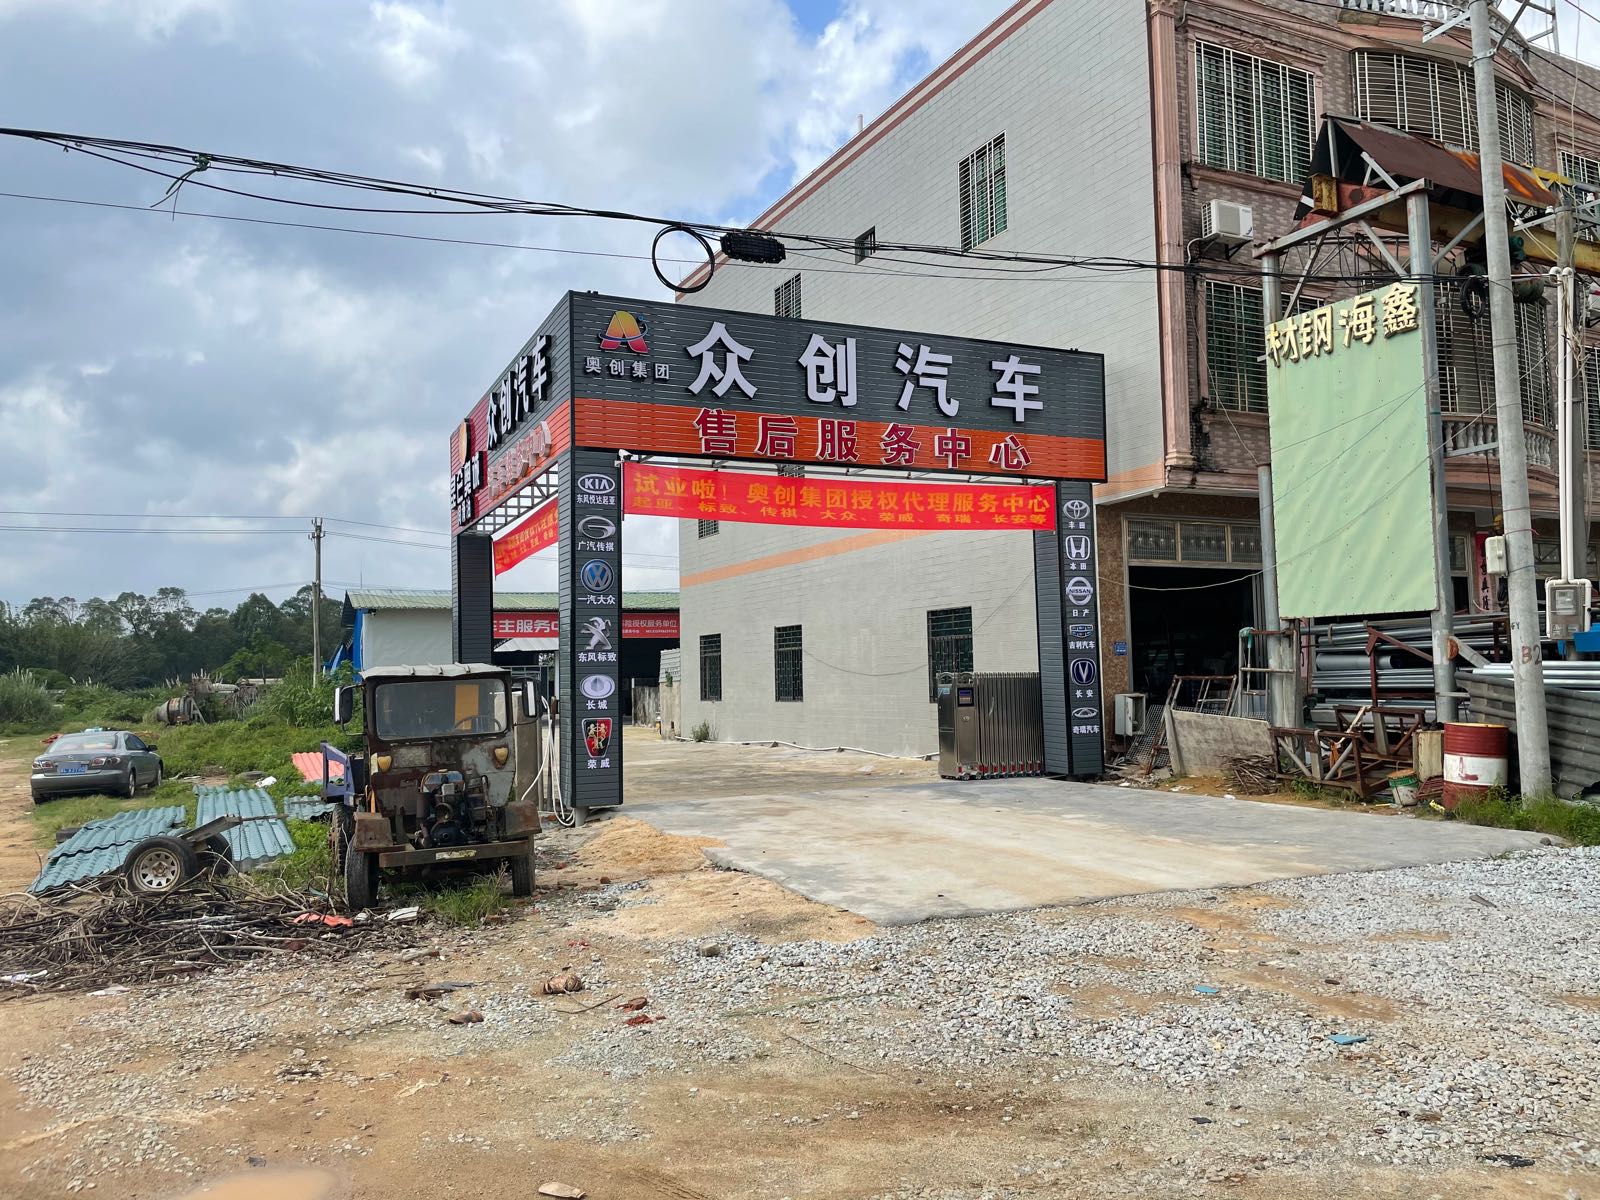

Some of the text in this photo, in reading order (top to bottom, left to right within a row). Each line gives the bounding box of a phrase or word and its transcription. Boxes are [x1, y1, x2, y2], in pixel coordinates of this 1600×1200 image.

[584, 356, 670, 379] 奥创集团
[687, 321, 1043, 421] 众创汽车
[694, 408, 1032, 470] 售后服务中心
[584, 478, 609, 490] KIA
[577, 494, 615, 505] 东风悦达起亚
[1068, 521, 1086, 529] 丰田
[1070, 562, 1087, 570] 本田
[577, 595, 616, 605] 一汽大众
[1072, 609, 1090, 617] 日产
[1069, 640, 1096, 649] 吉利汽车
[578, 652, 617, 662] 东风标致
[1075, 689, 1094, 698] 长安
[586, 700, 608, 710] 长城
[1072, 725, 1100, 734] 奇瑞汽车
[587, 758, 611, 769] 荣威
